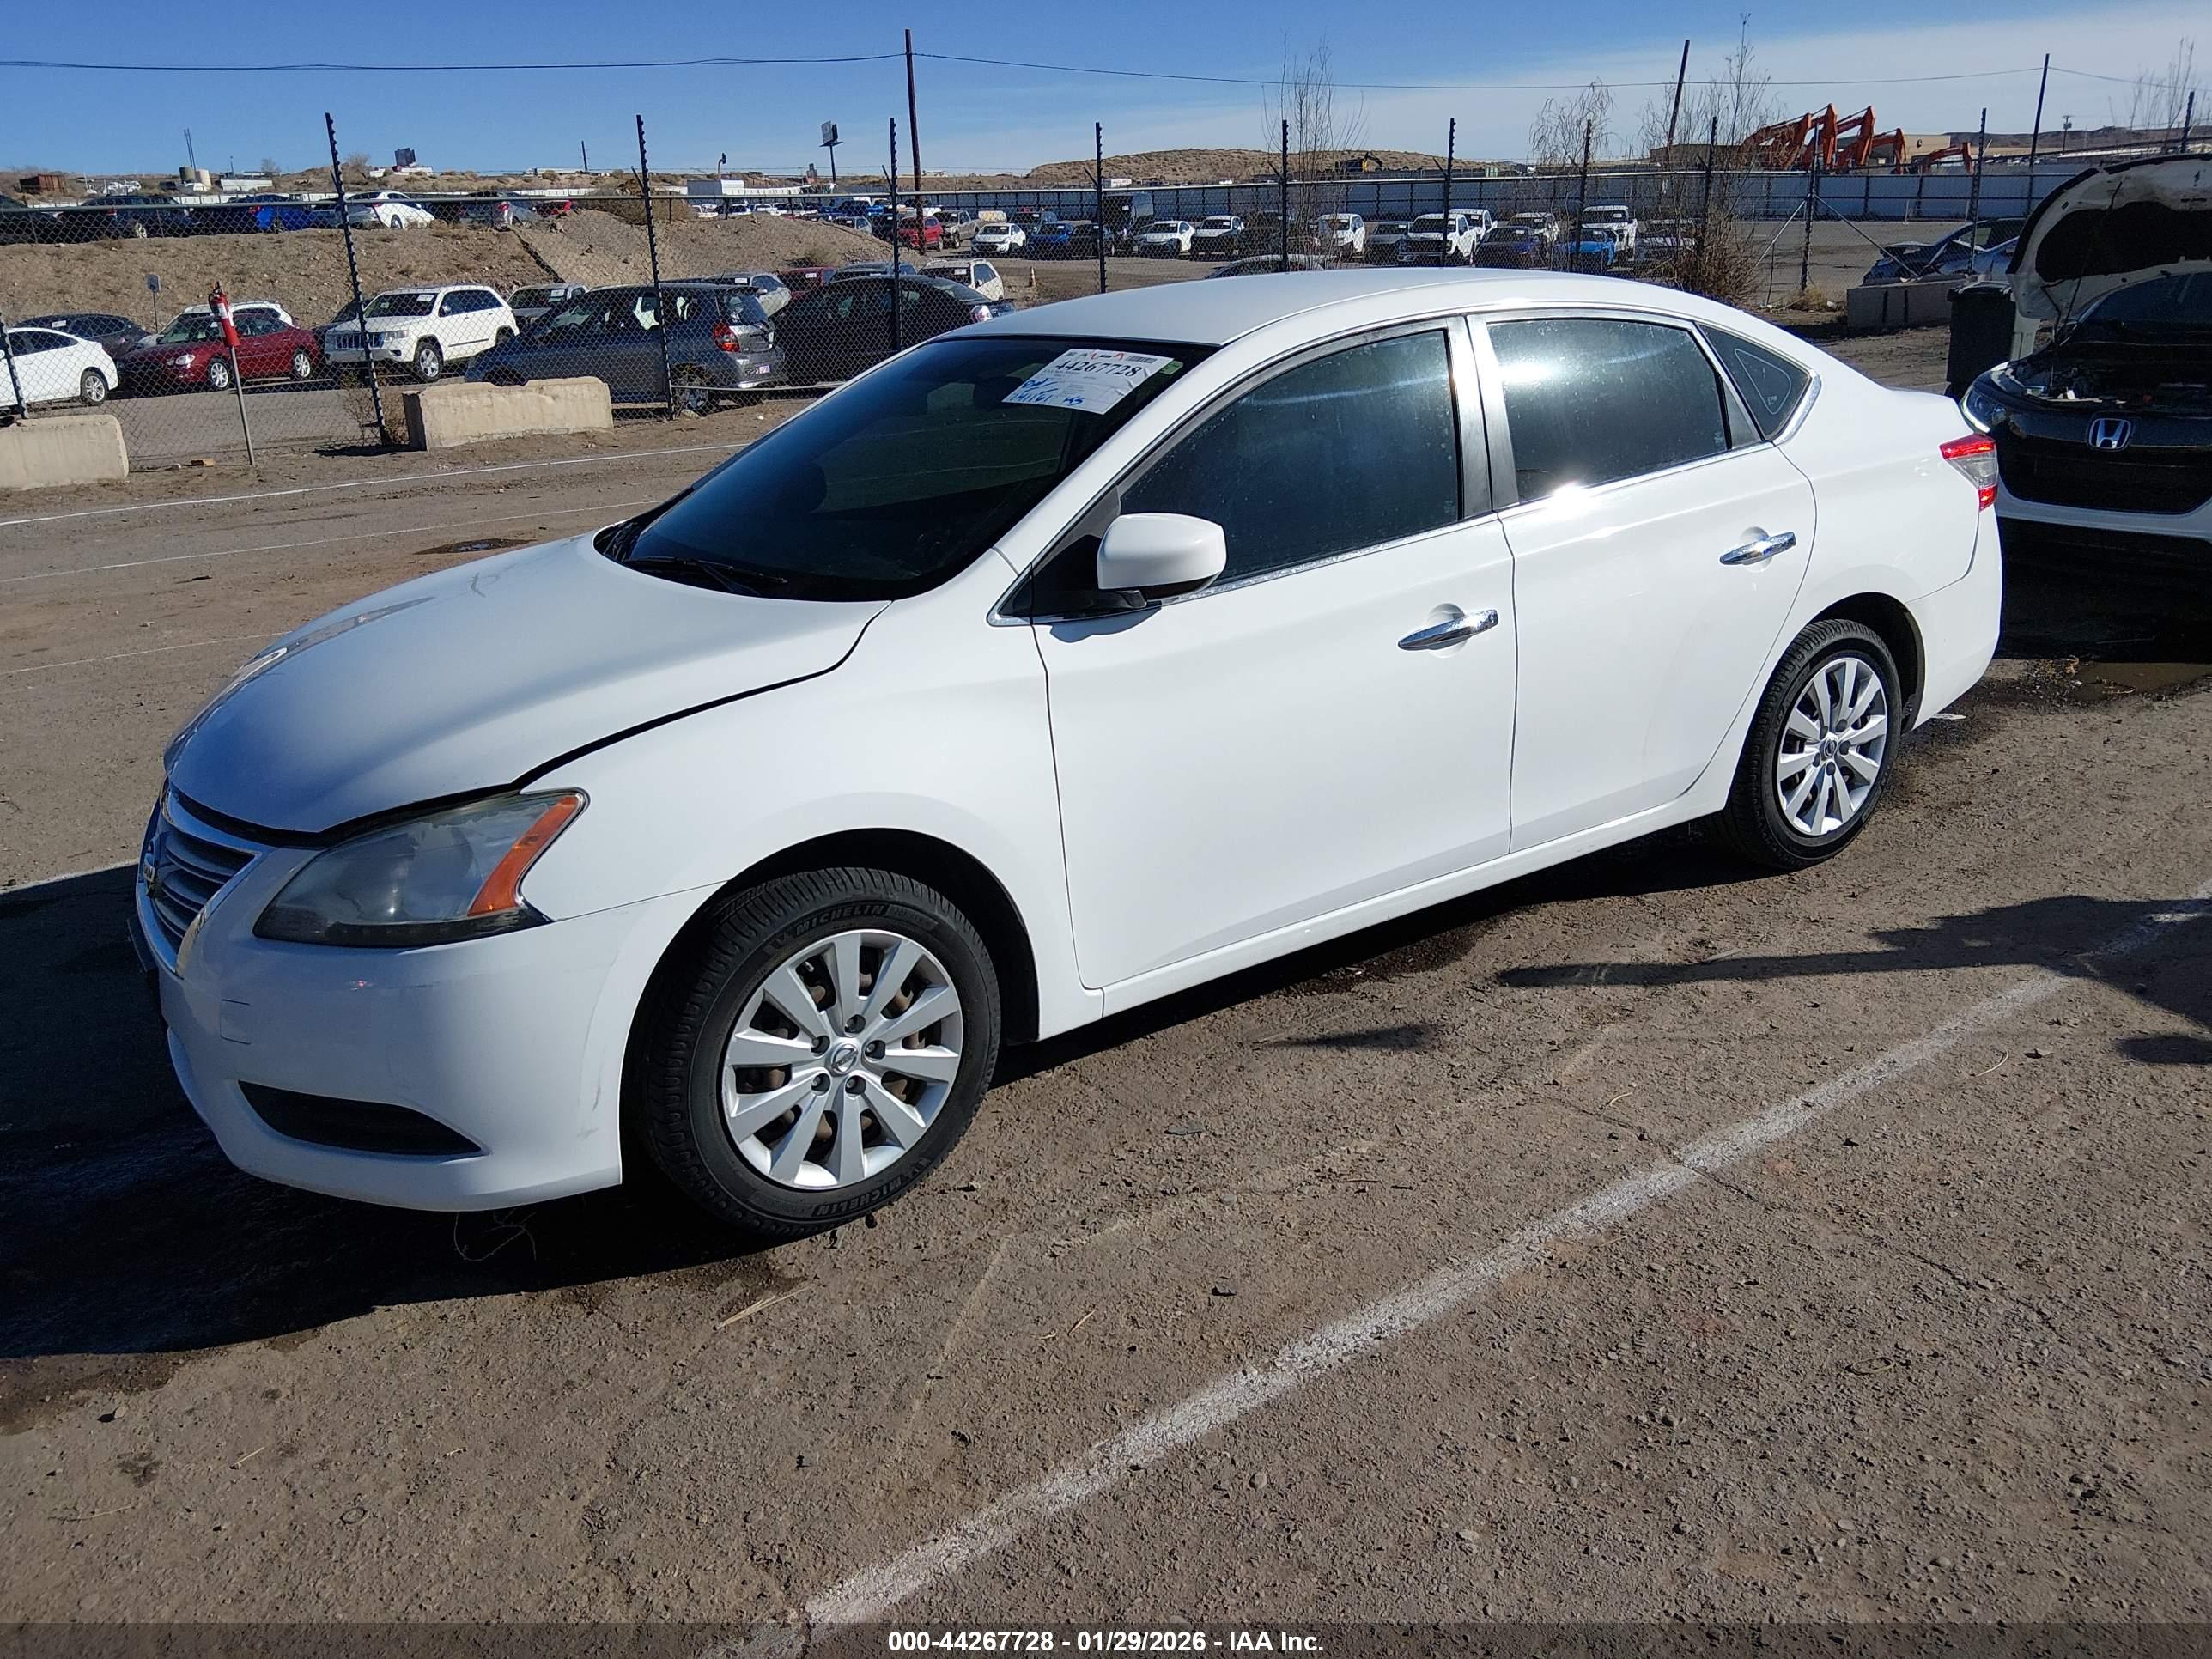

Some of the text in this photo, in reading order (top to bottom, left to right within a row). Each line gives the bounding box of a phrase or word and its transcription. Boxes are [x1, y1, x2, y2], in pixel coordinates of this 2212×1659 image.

[1055, 360, 1142, 377] 44267728
[795, 903, 886, 936] MICHELIN
[816, 1176, 903, 1217] MICHELIN
